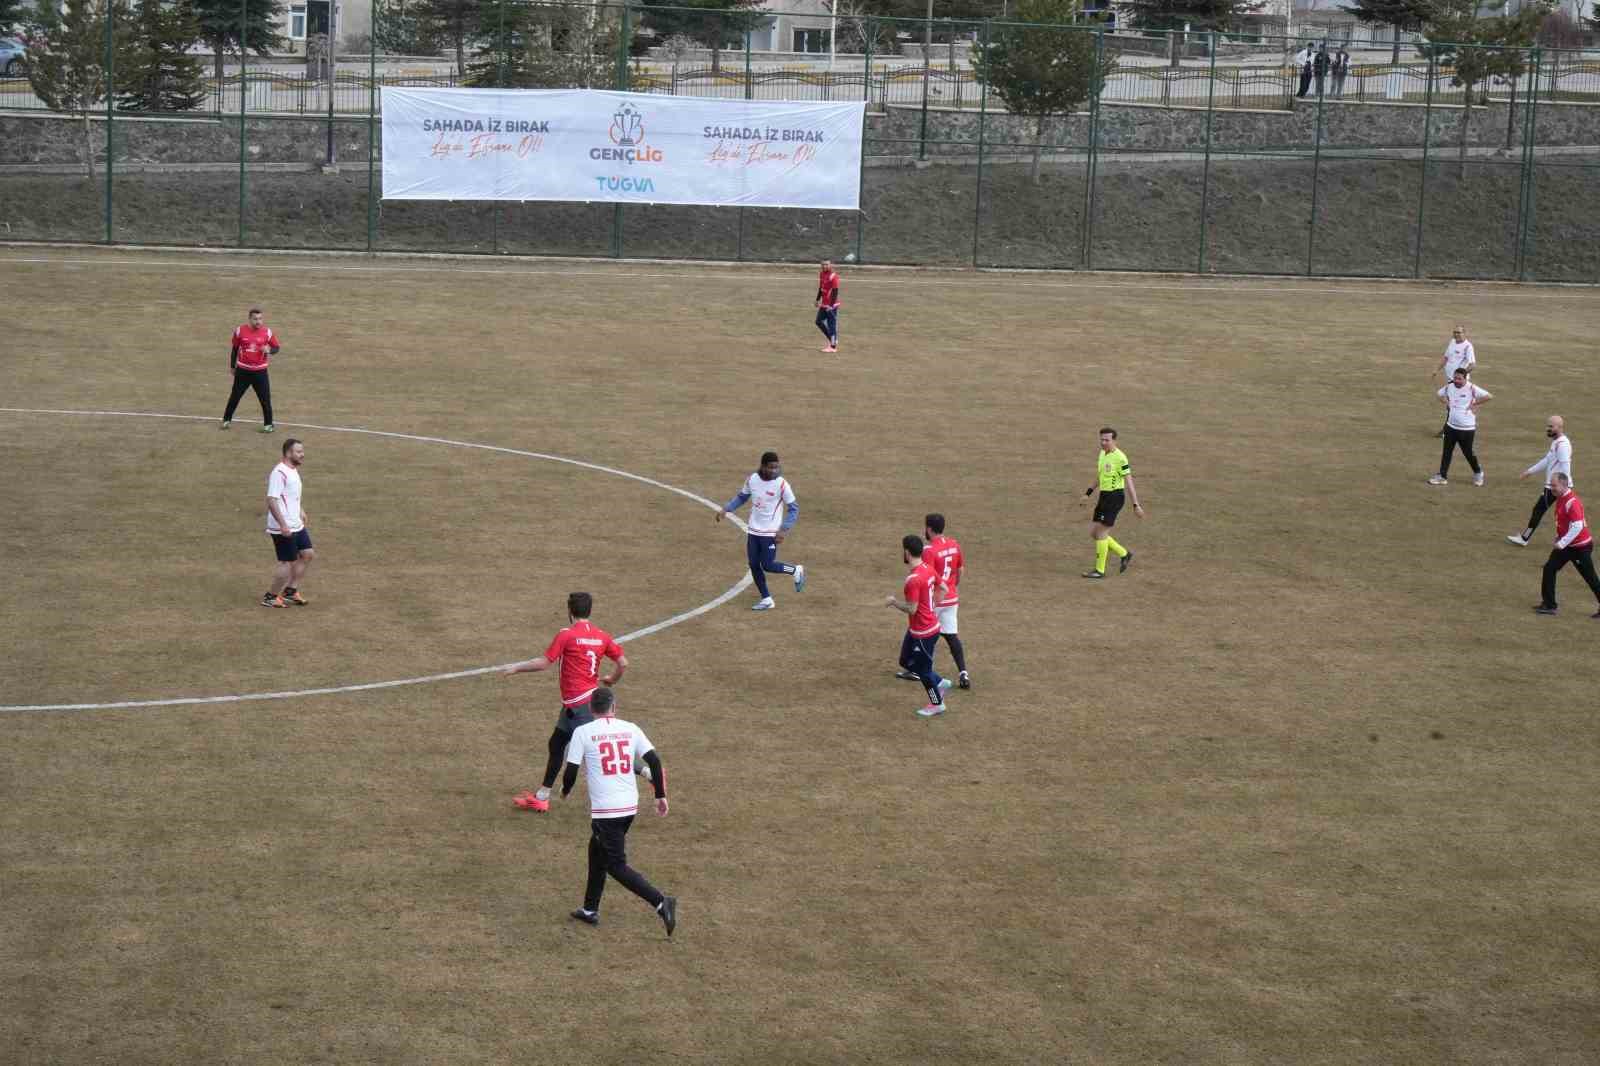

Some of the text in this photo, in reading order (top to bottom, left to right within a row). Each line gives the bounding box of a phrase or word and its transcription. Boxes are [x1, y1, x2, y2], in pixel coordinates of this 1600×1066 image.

[423, 117, 549, 133] SAHADA İZ BIRAK
[703, 126, 824, 143] SAHADA İZ BIRAK
[599, 740, 631, 775] 25
